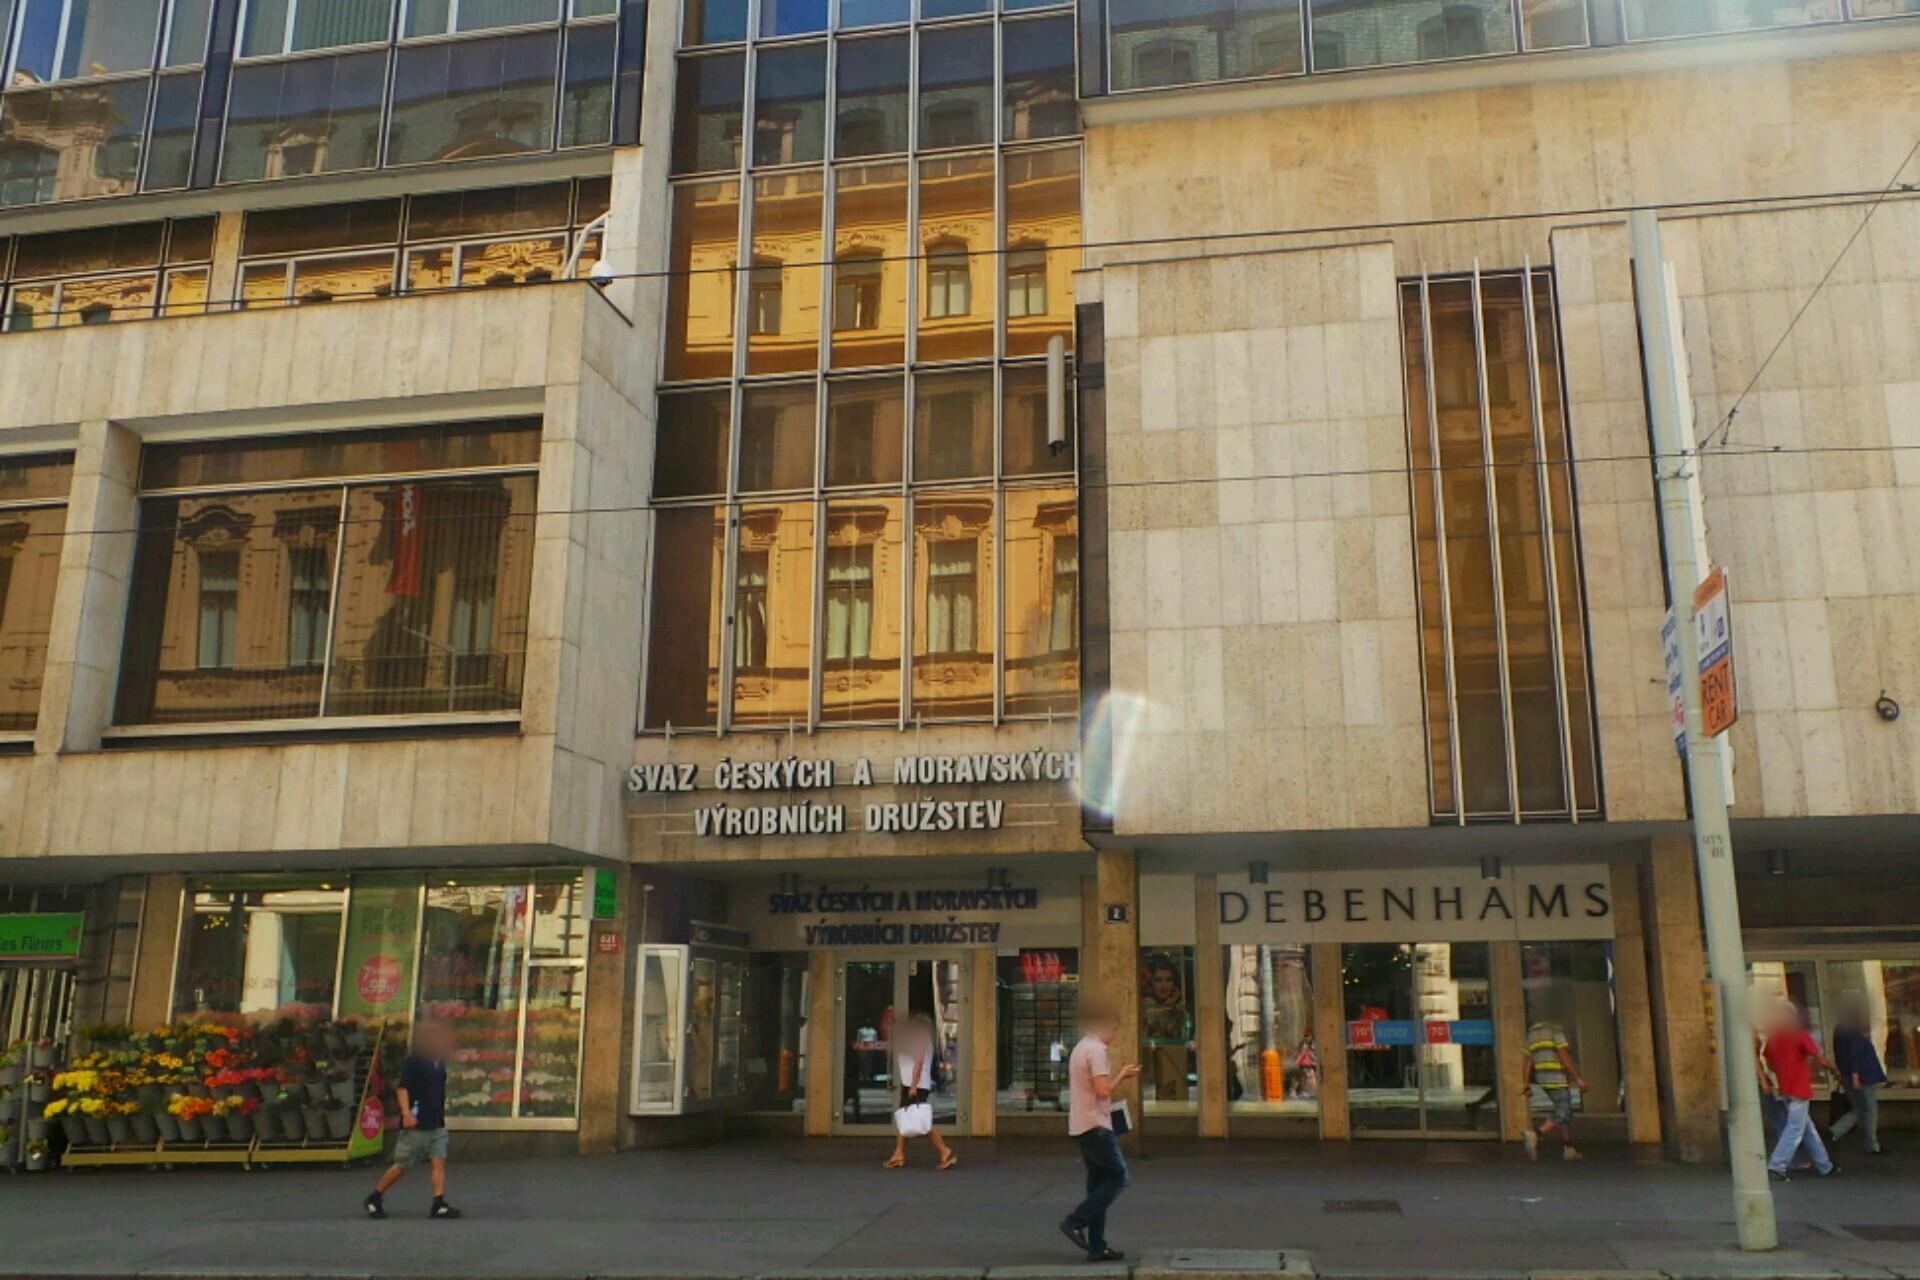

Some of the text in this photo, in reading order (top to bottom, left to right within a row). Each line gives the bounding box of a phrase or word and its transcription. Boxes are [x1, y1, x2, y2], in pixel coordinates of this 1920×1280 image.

[627, 747, 1082, 793] SVAZ ČESKÝCH A MORAVSKÝCH
[694, 797, 1005, 837] VÝROBNÍCH DRUŽSTEV
[769, 881, 1038, 913] SVAZ ČESKÝCH A MORAVSKÝCH
[1219, 882, 1610, 925] DEBENHAMS
[21, 935, 64, 951] Fleurs
[805, 916, 1001, 945] VÝROBNÍCH DRUŽSTEV
